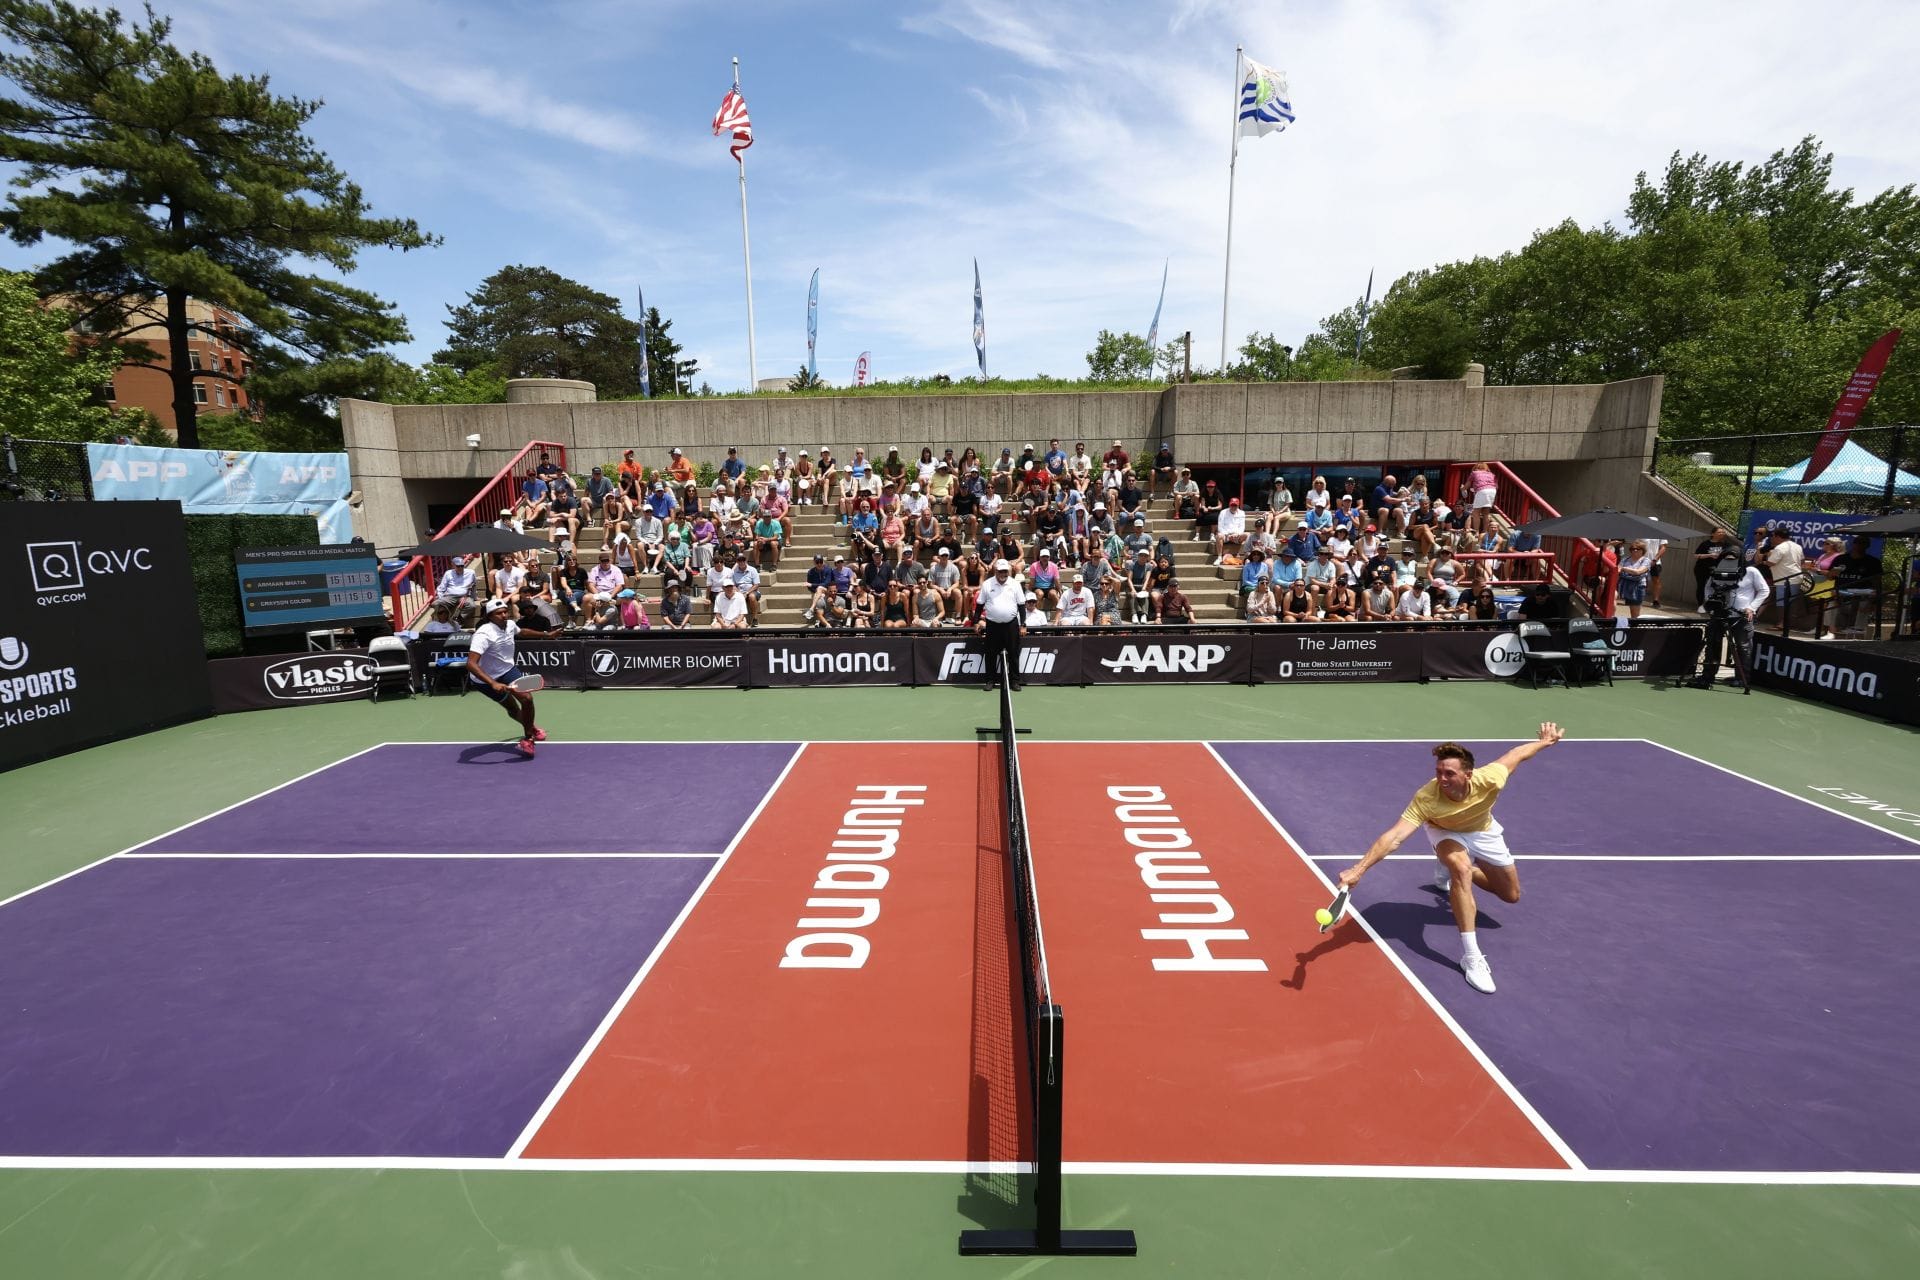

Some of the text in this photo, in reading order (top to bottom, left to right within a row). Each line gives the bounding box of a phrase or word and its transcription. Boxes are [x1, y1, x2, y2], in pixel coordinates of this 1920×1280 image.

[94, 459, 187, 482] APP
[279, 466, 337, 484] APP
[1776, 519, 1803, 533] CBS
[42, 553, 72, 578] Q
[87, 547, 153, 574] QVC
[330, 575, 340, 585] 15
[347, 575, 355, 584] 11
[364, 574, 370, 582] 3
[36, 592, 87, 606] QVC.COM
[333, 593, 341, 602] 11
[348, 592, 359, 601] 15
[366, 591, 373, 600] 0
[1297, 637, 1377, 650] The James
[515, 650, 572, 667] ANIST
[595, 653, 615, 673] Z
[623, 655, 743, 669] ZIMMER BIOMET
[937, 642, 1056, 680] fralin
[1100, 644, 1226, 673] AARP
[1614, 649, 1645, 662] PORTS
[0, 666, 78, 704] SPORTS
[310, 685, 341, 694] PICKLES
[1807, 785, 1920, 823] OMET
[778, 785, 927, 969] Humana
[1106, 785, 1269, 972] Humana
